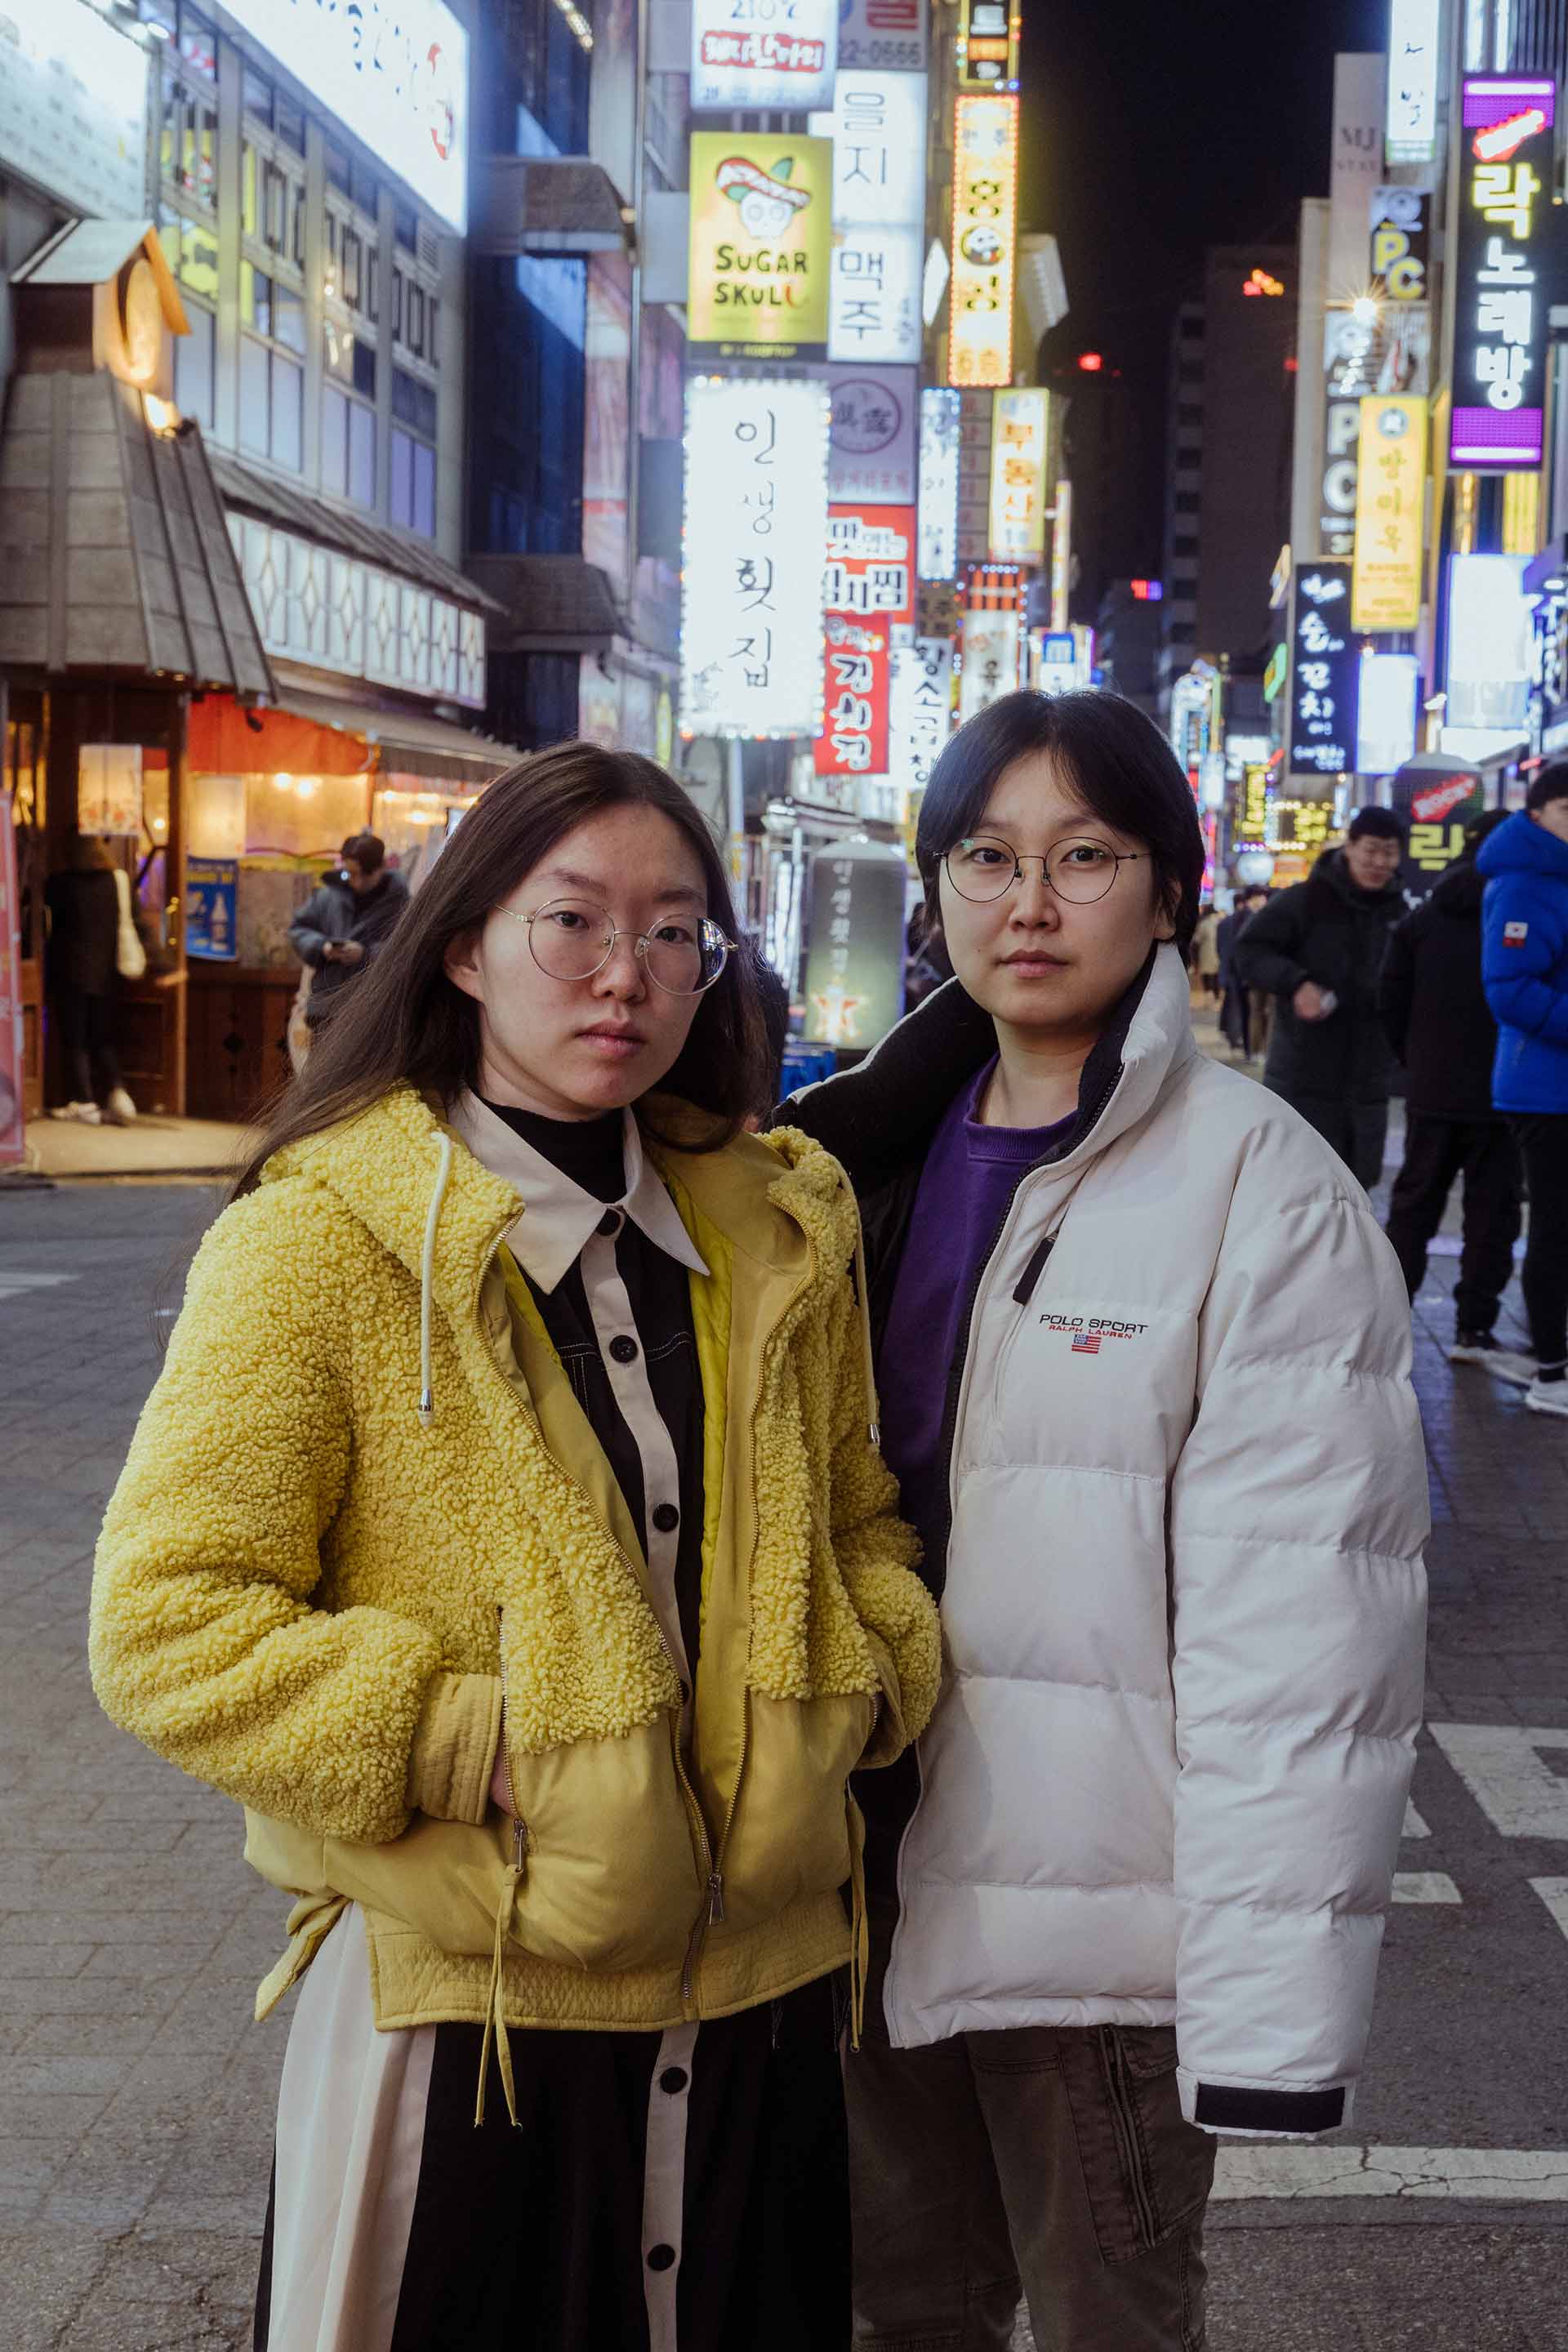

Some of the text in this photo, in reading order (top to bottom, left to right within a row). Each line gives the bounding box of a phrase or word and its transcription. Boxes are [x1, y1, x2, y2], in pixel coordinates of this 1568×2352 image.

[840, 92, 886, 341] 을지 맥주
[715, 245, 808, 273] SUGAR
[1374, 229, 1426, 300] PC
[1474, 236, 1536, 411] 노래방
[1039, 1314, 1148, 1334] POLO SPORT
[1049, 1325, 1133, 1339] RALPH LAUREN
